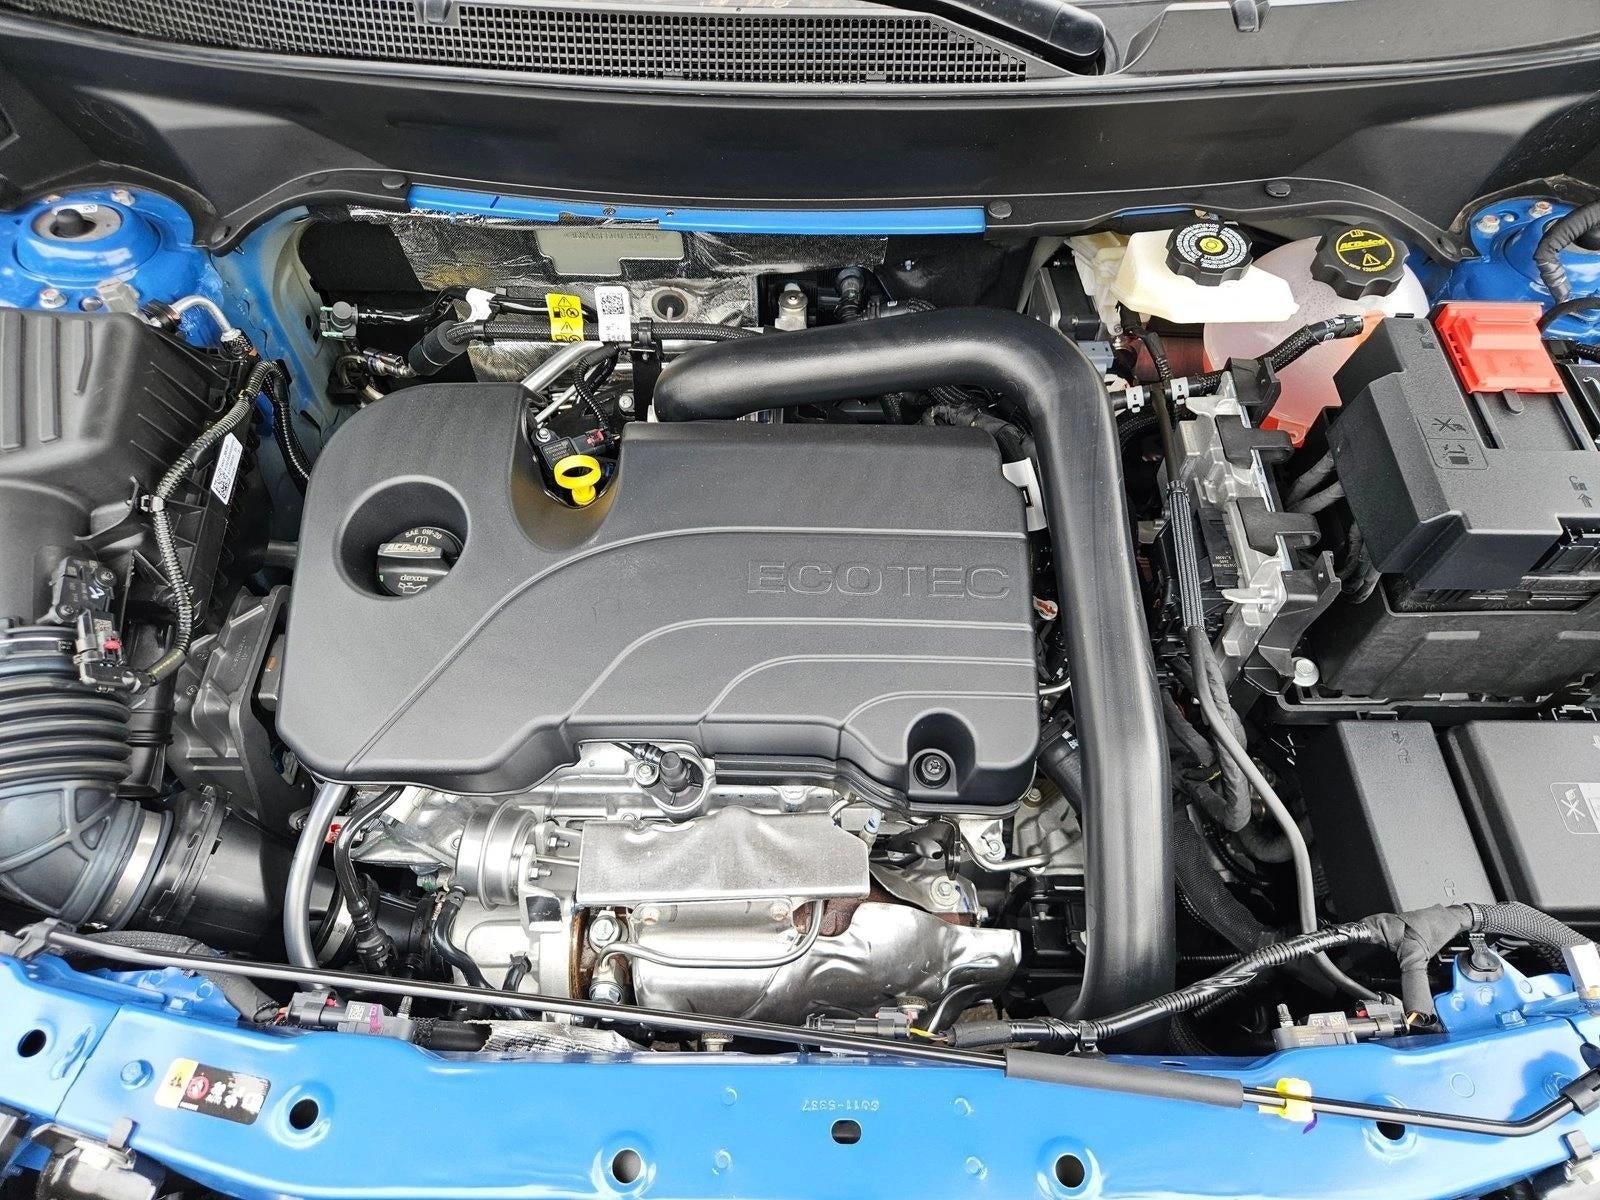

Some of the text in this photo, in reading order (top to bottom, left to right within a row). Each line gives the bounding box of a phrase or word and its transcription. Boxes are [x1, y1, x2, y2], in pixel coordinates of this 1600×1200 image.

[405, 529, 418, 538] SAE
[384, 543, 436, 553] ACDelco
[400, 574, 429, 582] dexos
[747, 561, 1010, 599] ECOTEC
